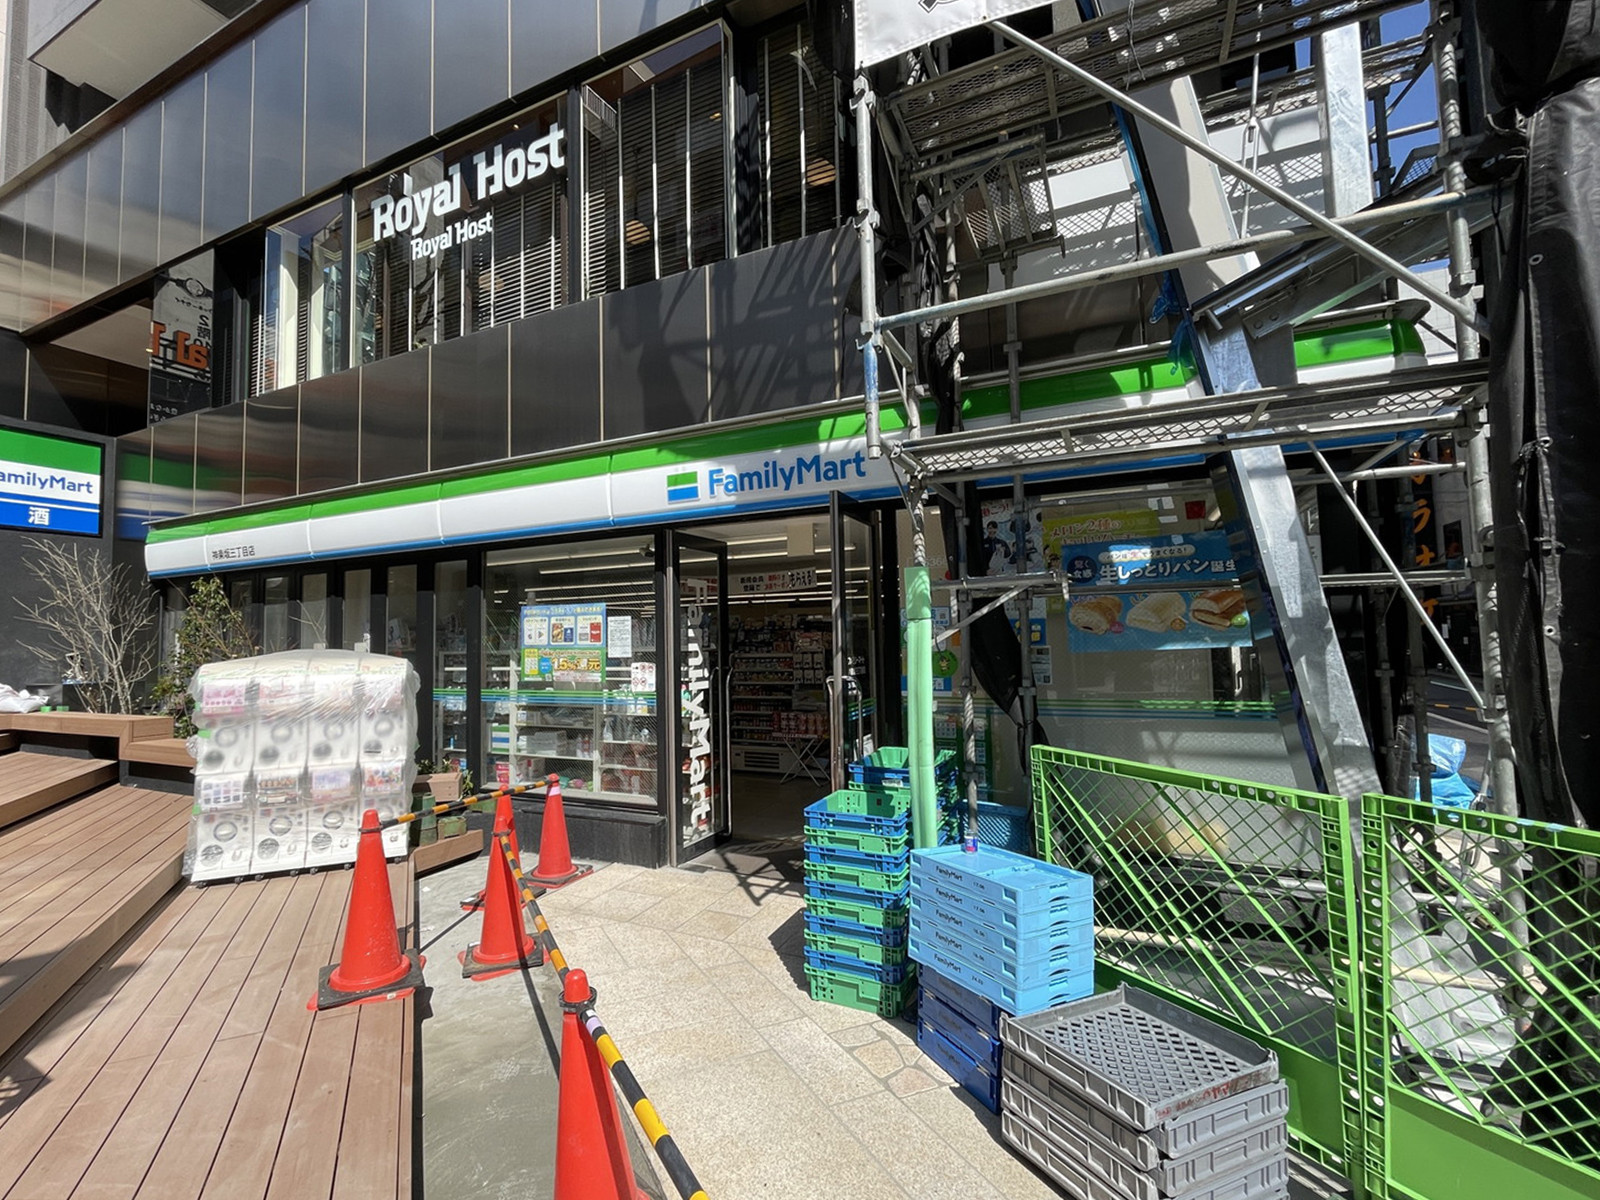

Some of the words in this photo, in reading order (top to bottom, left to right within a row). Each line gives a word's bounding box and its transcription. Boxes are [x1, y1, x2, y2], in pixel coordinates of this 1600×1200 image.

[370, 162, 462, 242] Royal
[473, 122, 566, 201] Host
[410, 224, 453, 261] Royal
[454, 211, 493, 244] Host
[0, 471, 93, 494] amilyMart
[708, 450, 867, 497] FamilyMart
[28, 506, 50, 526] 酒
[1099, 558, 1237, 582] 生しっとりパン誕生
[682, 578, 712, 828] FamilyMart
[935, 865, 963, 881] FamilyMart
[935, 887, 963, 904] FamilyMart
[935, 909, 963, 927] FamilyMart
[935, 931, 963, 950] FamilyMart
[933, 953, 961, 973] FamilyMart
